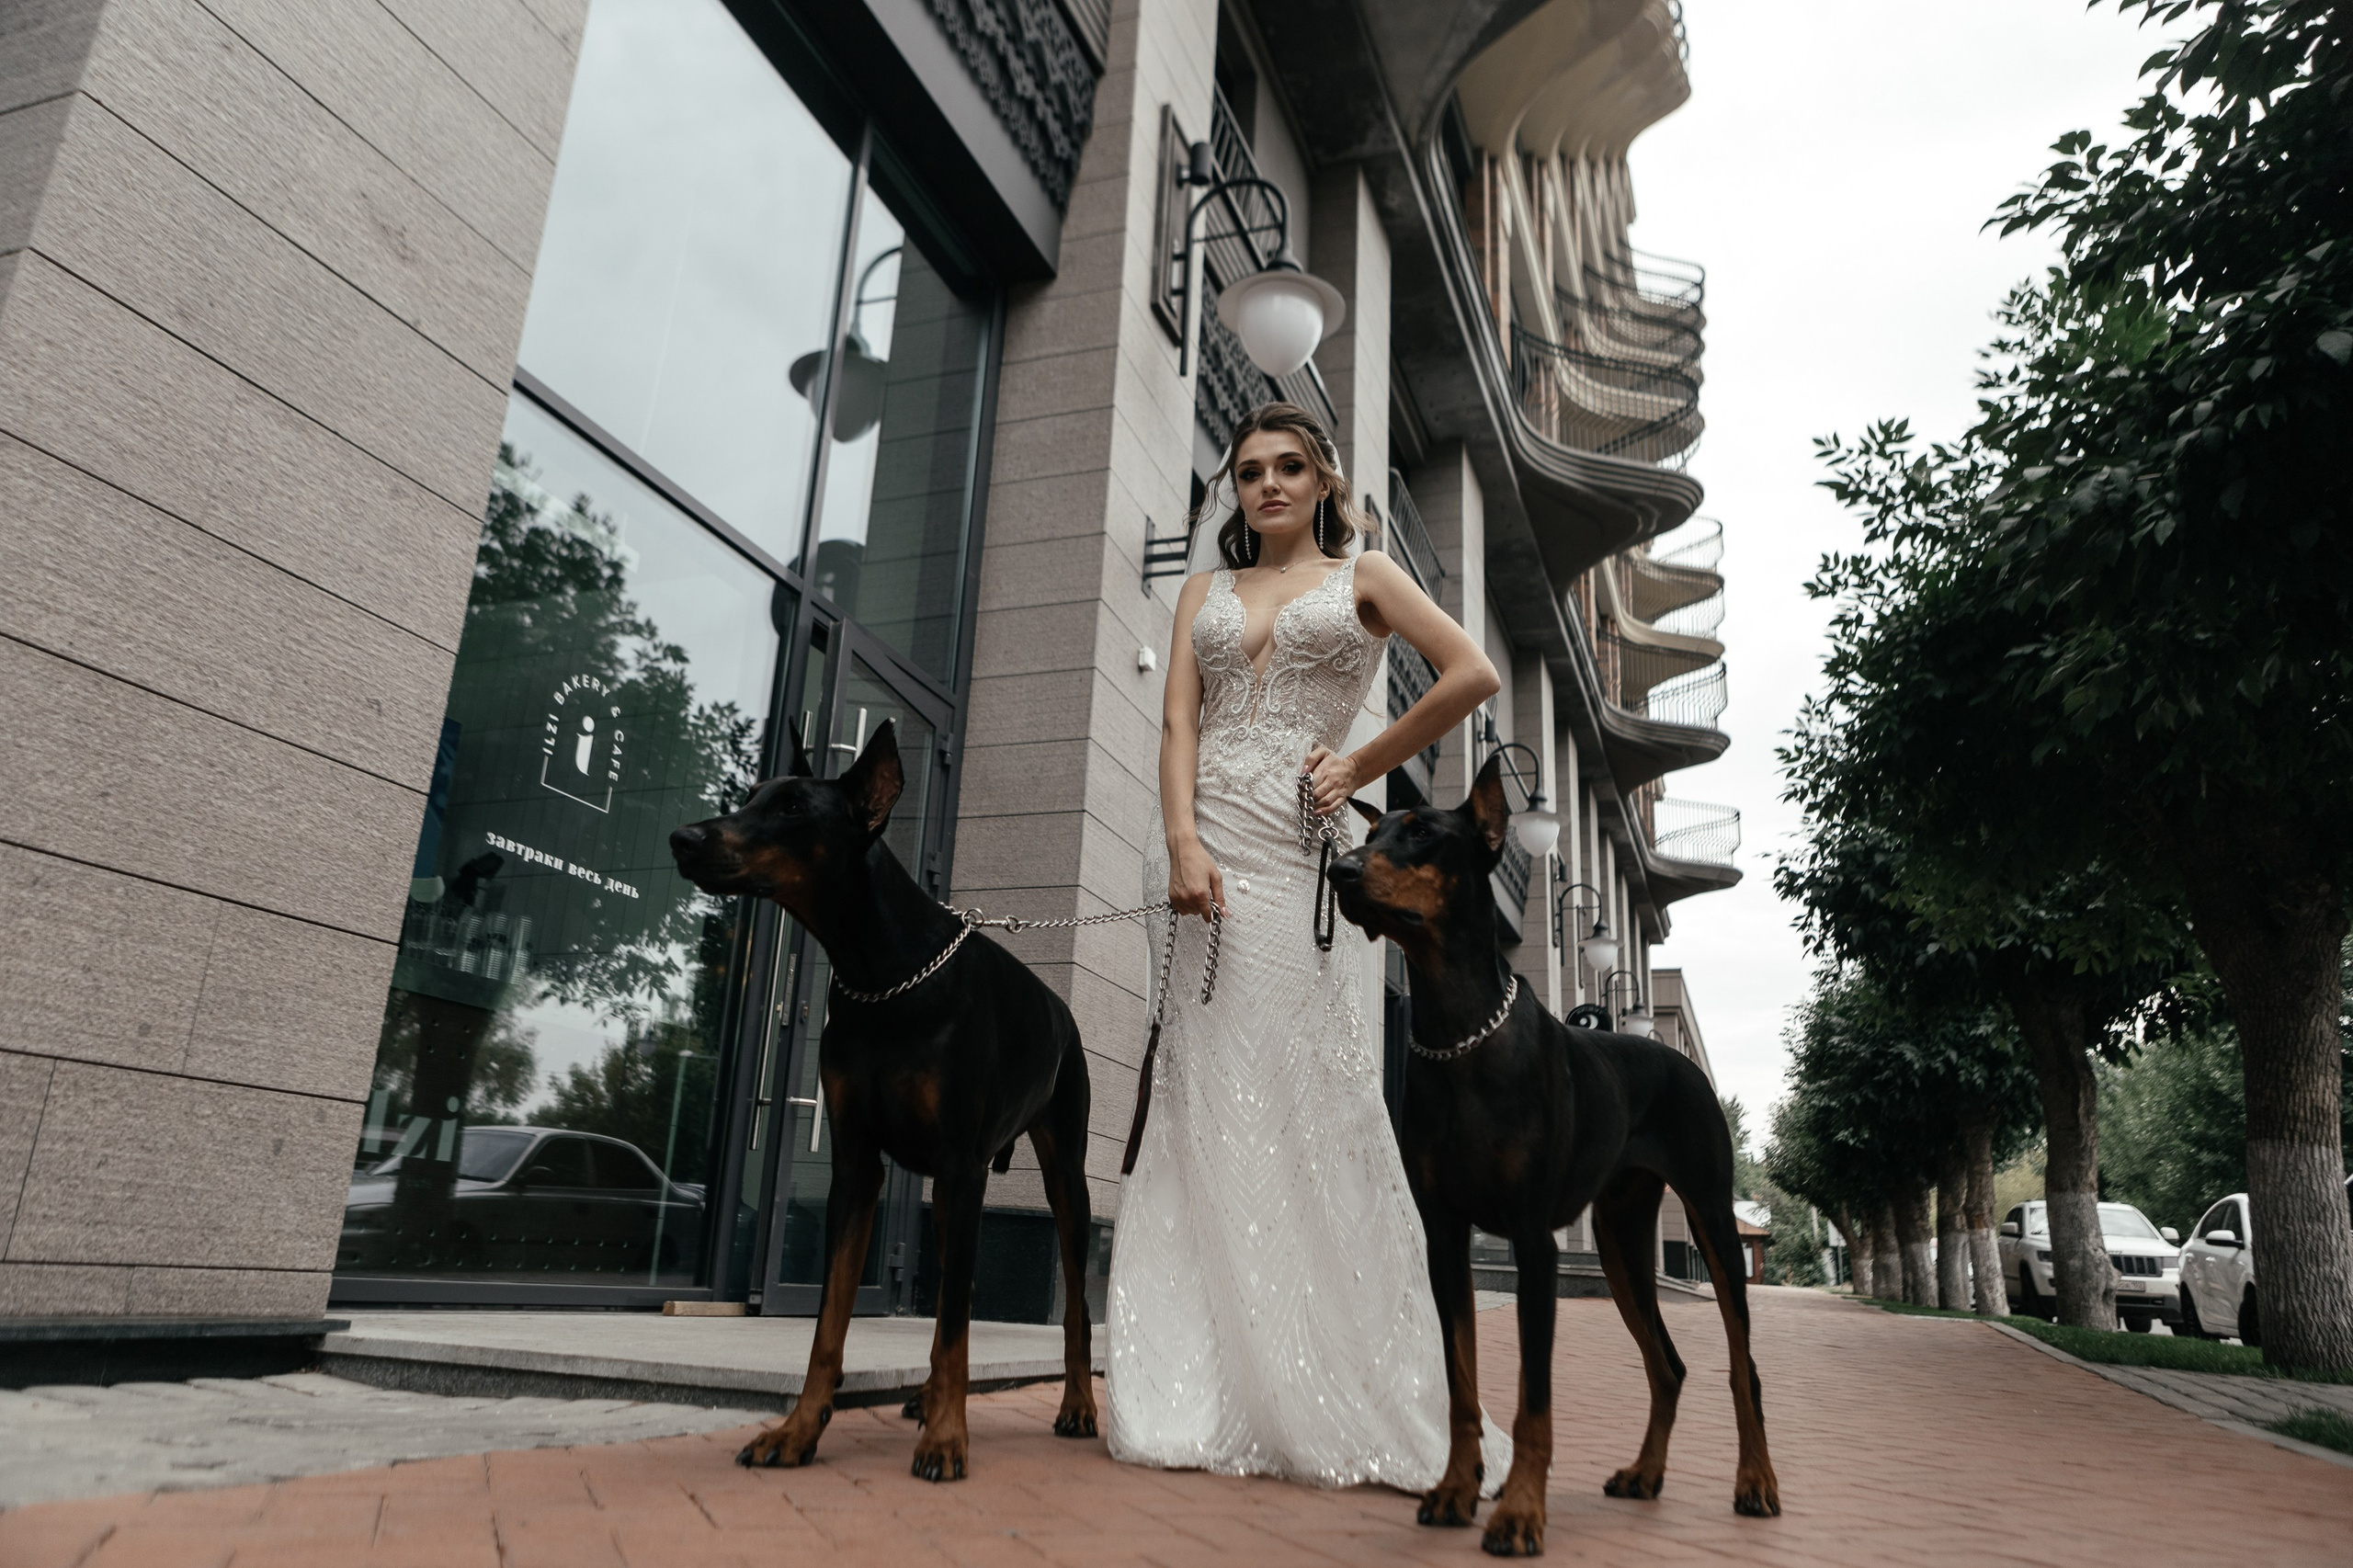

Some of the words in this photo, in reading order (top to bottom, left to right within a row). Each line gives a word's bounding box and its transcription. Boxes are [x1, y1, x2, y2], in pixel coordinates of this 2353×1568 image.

[553, 674, 609, 705] BAKERY
[610, 706, 621, 718] &
[542, 713, 559, 755] ILZI
[608, 729, 624, 781] CAFE
[485, 831, 564, 871] завтраки
[568, 862, 602, 885] весь
[604, 877, 640, 899] день
[363, 1090, 459, 1162] lzi
